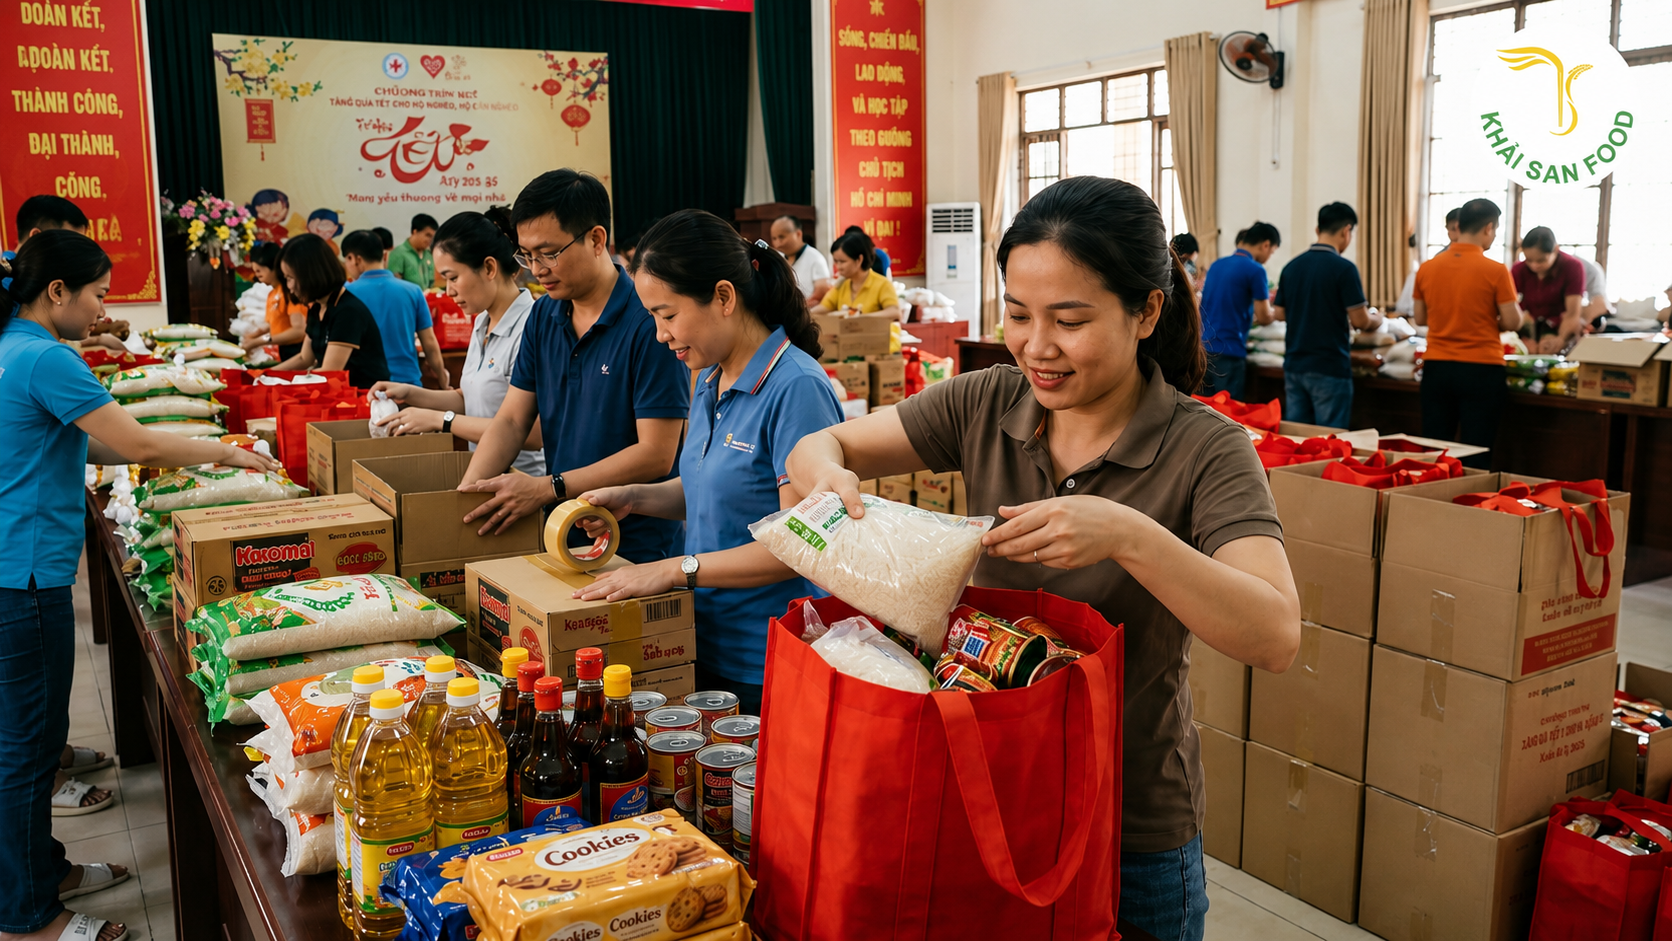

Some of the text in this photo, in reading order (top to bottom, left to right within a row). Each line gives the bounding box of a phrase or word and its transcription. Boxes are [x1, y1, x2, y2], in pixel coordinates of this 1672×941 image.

[855, 63, 875, 82] LAO
[11, 86, 69, 114] THÀNH
[392, 99, 411, 109] CHO
[868, 97, 888, 118] HỌC
[28, 129, 120, 160] ĐẠI THÀNH,
[849, 129, 876, 147] THEO
[885, 191, 913, 208] MINH
[544, 830, 641, 866] Cookies
[610, 908, 662, 933] Cookies
